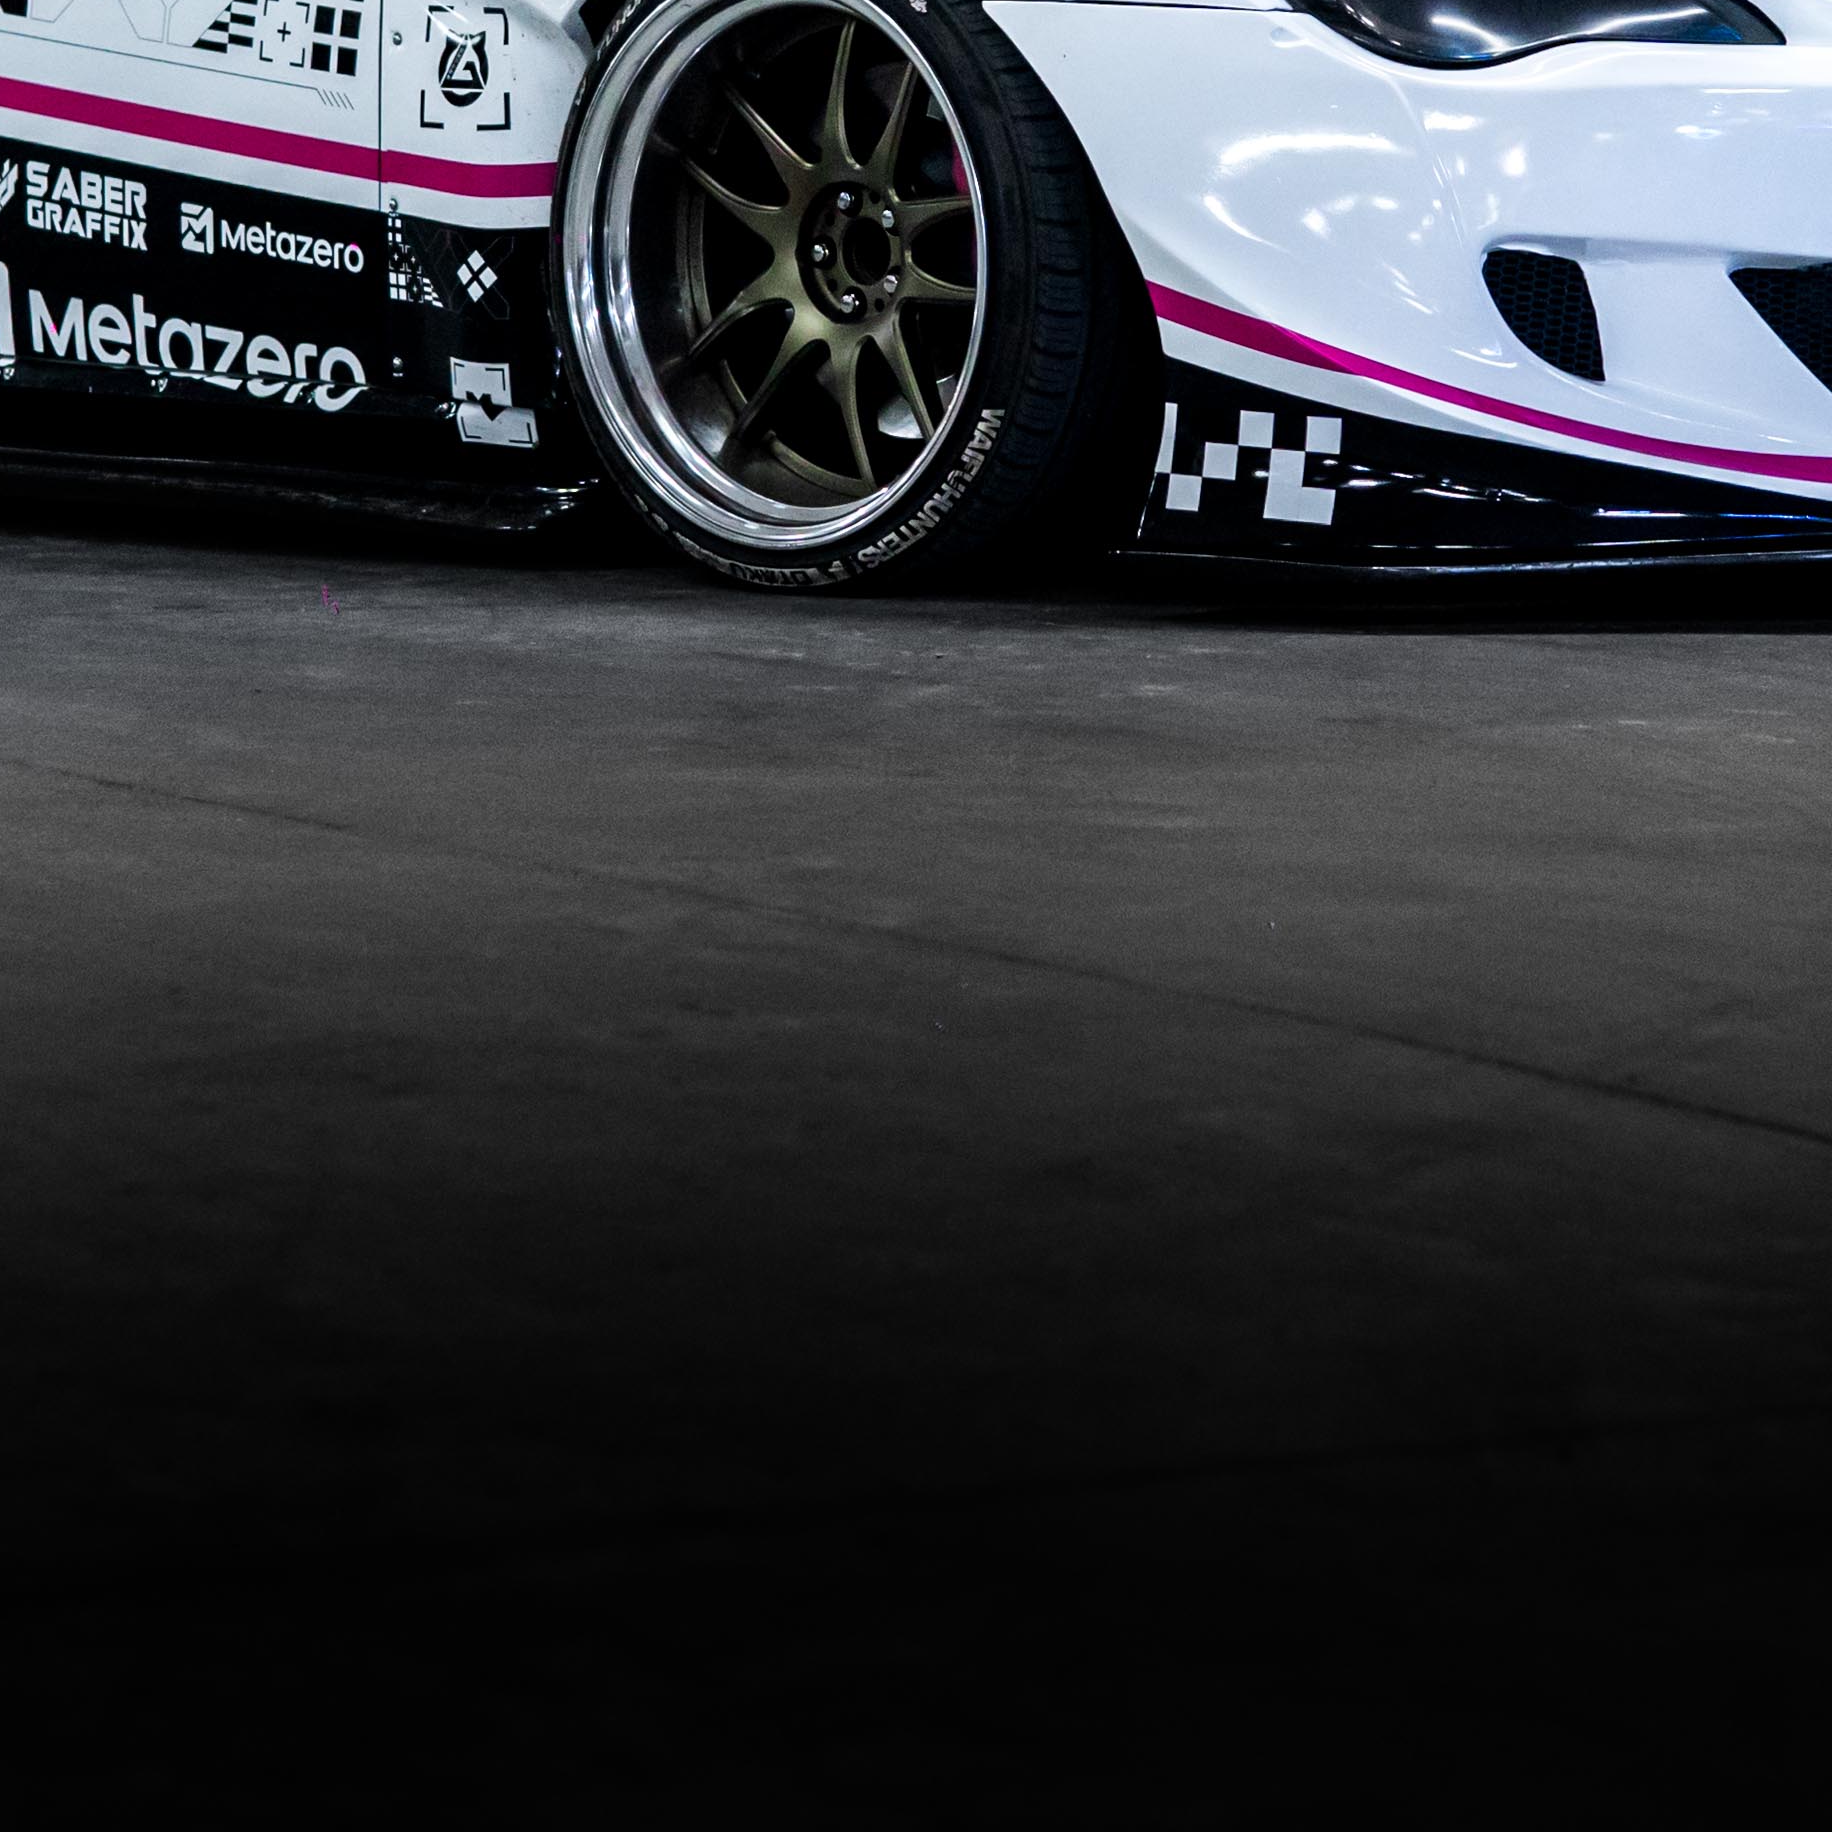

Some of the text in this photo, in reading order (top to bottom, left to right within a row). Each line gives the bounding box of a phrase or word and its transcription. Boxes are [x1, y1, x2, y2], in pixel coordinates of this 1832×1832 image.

[26, 160, 147, 214] SABER
[26, 196, 148, 251] GRAFFIX
[220, 218, 364, 274] Metazero
[31, 287, 366, 412] Metazero
